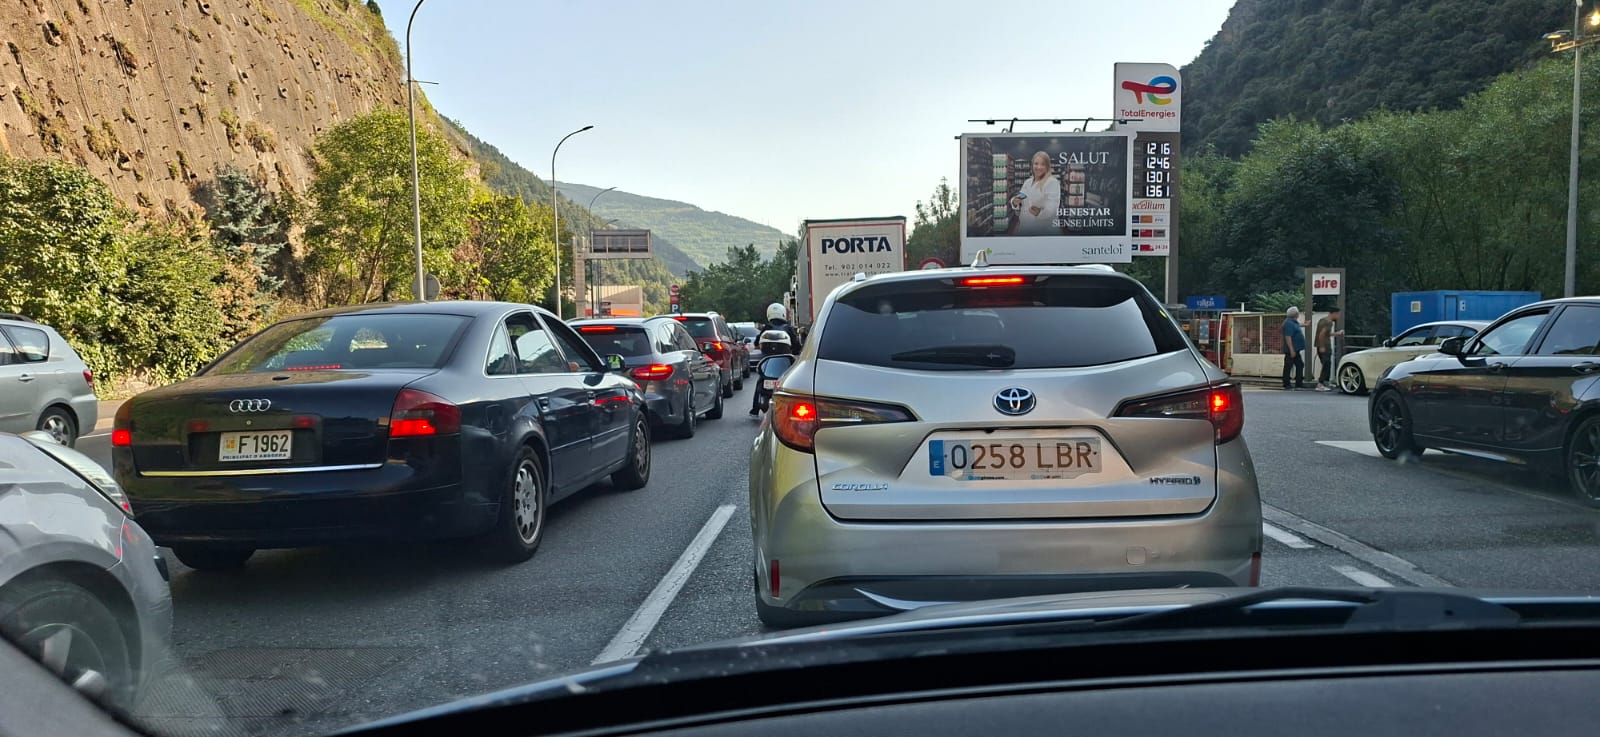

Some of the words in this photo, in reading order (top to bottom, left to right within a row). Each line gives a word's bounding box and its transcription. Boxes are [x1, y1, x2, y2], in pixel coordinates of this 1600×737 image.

[1121, 109, 1176, 119] TotalEnergies
[1058, 151, 1110, 165] SALUT
[1056, 207, 1111, 216] BENESTAR
[1052, 218, 1081, 227] SENSE
[821, 236, 892, 254] PORTA
[1314, 275, 1338, 289] aire
[951, 443, 1026, 470] 0258
[1036, 442, 1093, 469] LBR
[1150, 476, 1193, 485] HYBRID
[832, 482, 888, 491] COROLLA
